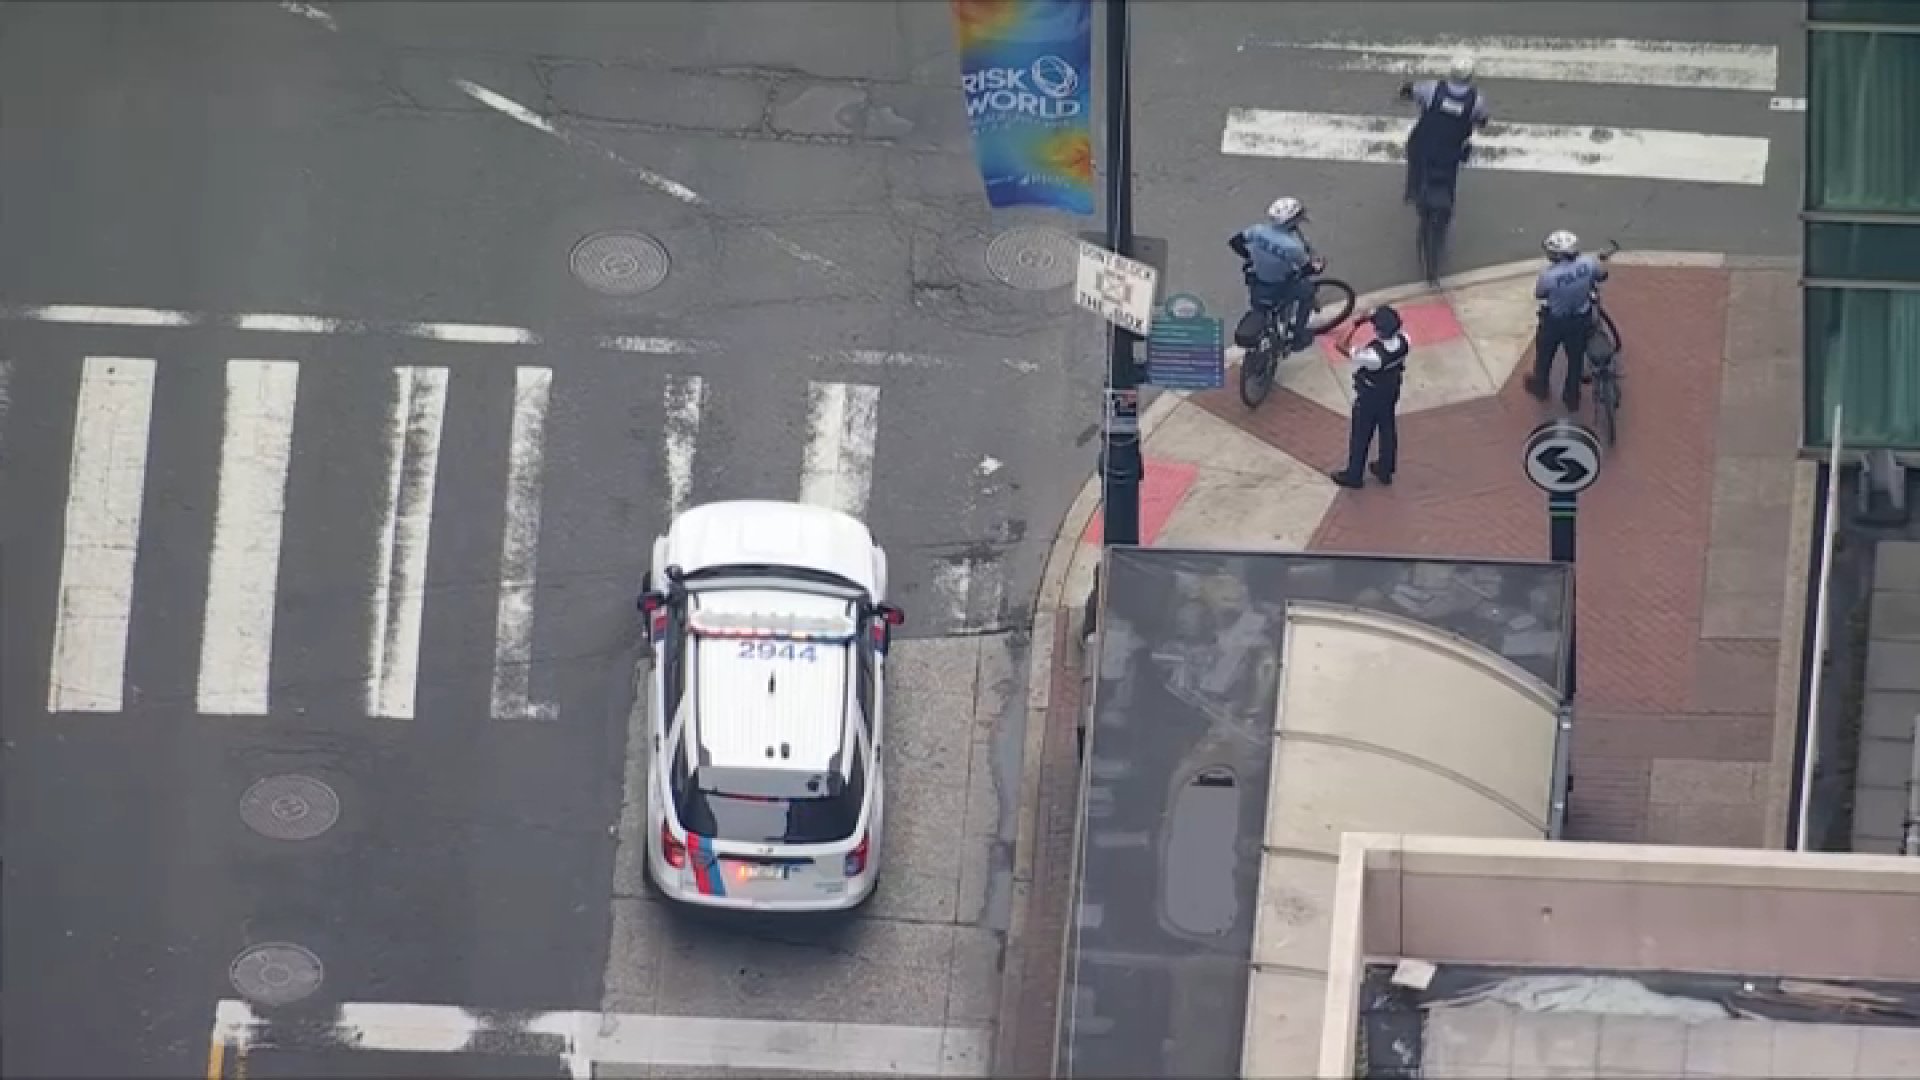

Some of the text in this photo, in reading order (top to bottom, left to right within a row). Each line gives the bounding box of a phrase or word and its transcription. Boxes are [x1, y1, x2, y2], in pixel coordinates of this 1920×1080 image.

[962, 67, 1027, 93] RISK
[966, 91, 1081, 119] WORLD
[738, 641, 818, 663] 2944
